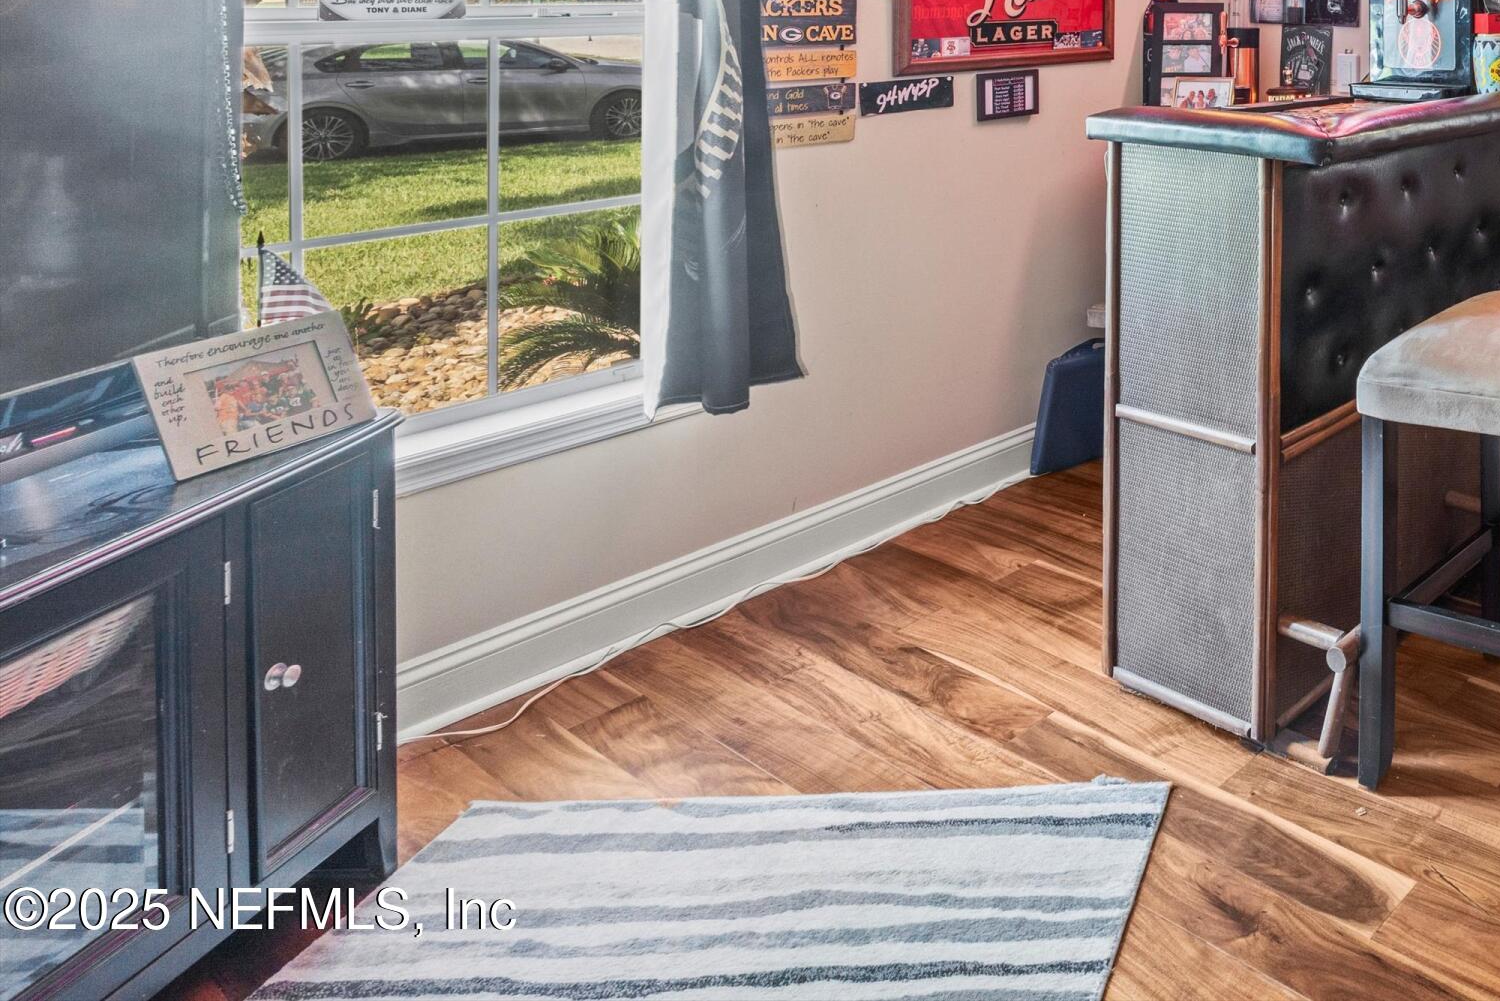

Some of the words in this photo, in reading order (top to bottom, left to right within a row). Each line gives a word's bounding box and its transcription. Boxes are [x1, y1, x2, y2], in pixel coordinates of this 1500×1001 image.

[401, 6, 428, 14] DIANE
[806, 24, 854, 41] CAVE
[976, 24, 1054, 43] LAGER
[799, 53, 817, 62] ALL
[820, 53, 854, 62] remotes
[786, 67, 820, 77] Packers
[823, 65, 839, 77] play
[785, 88, 805, 101] Gold
[156, 351, 204, 369] Therefore
[207, 335, 271, 358] encourage
[274, 330, 289, 340] one
[291, 322, 325, 337] another
[154, 377, 173, 387] and
[154, 384, 186, 400] build
[161, 396, 184, 407] each
[169, 414, 187, 427] up,
[196, 403, 355, 466] FRIENDS
